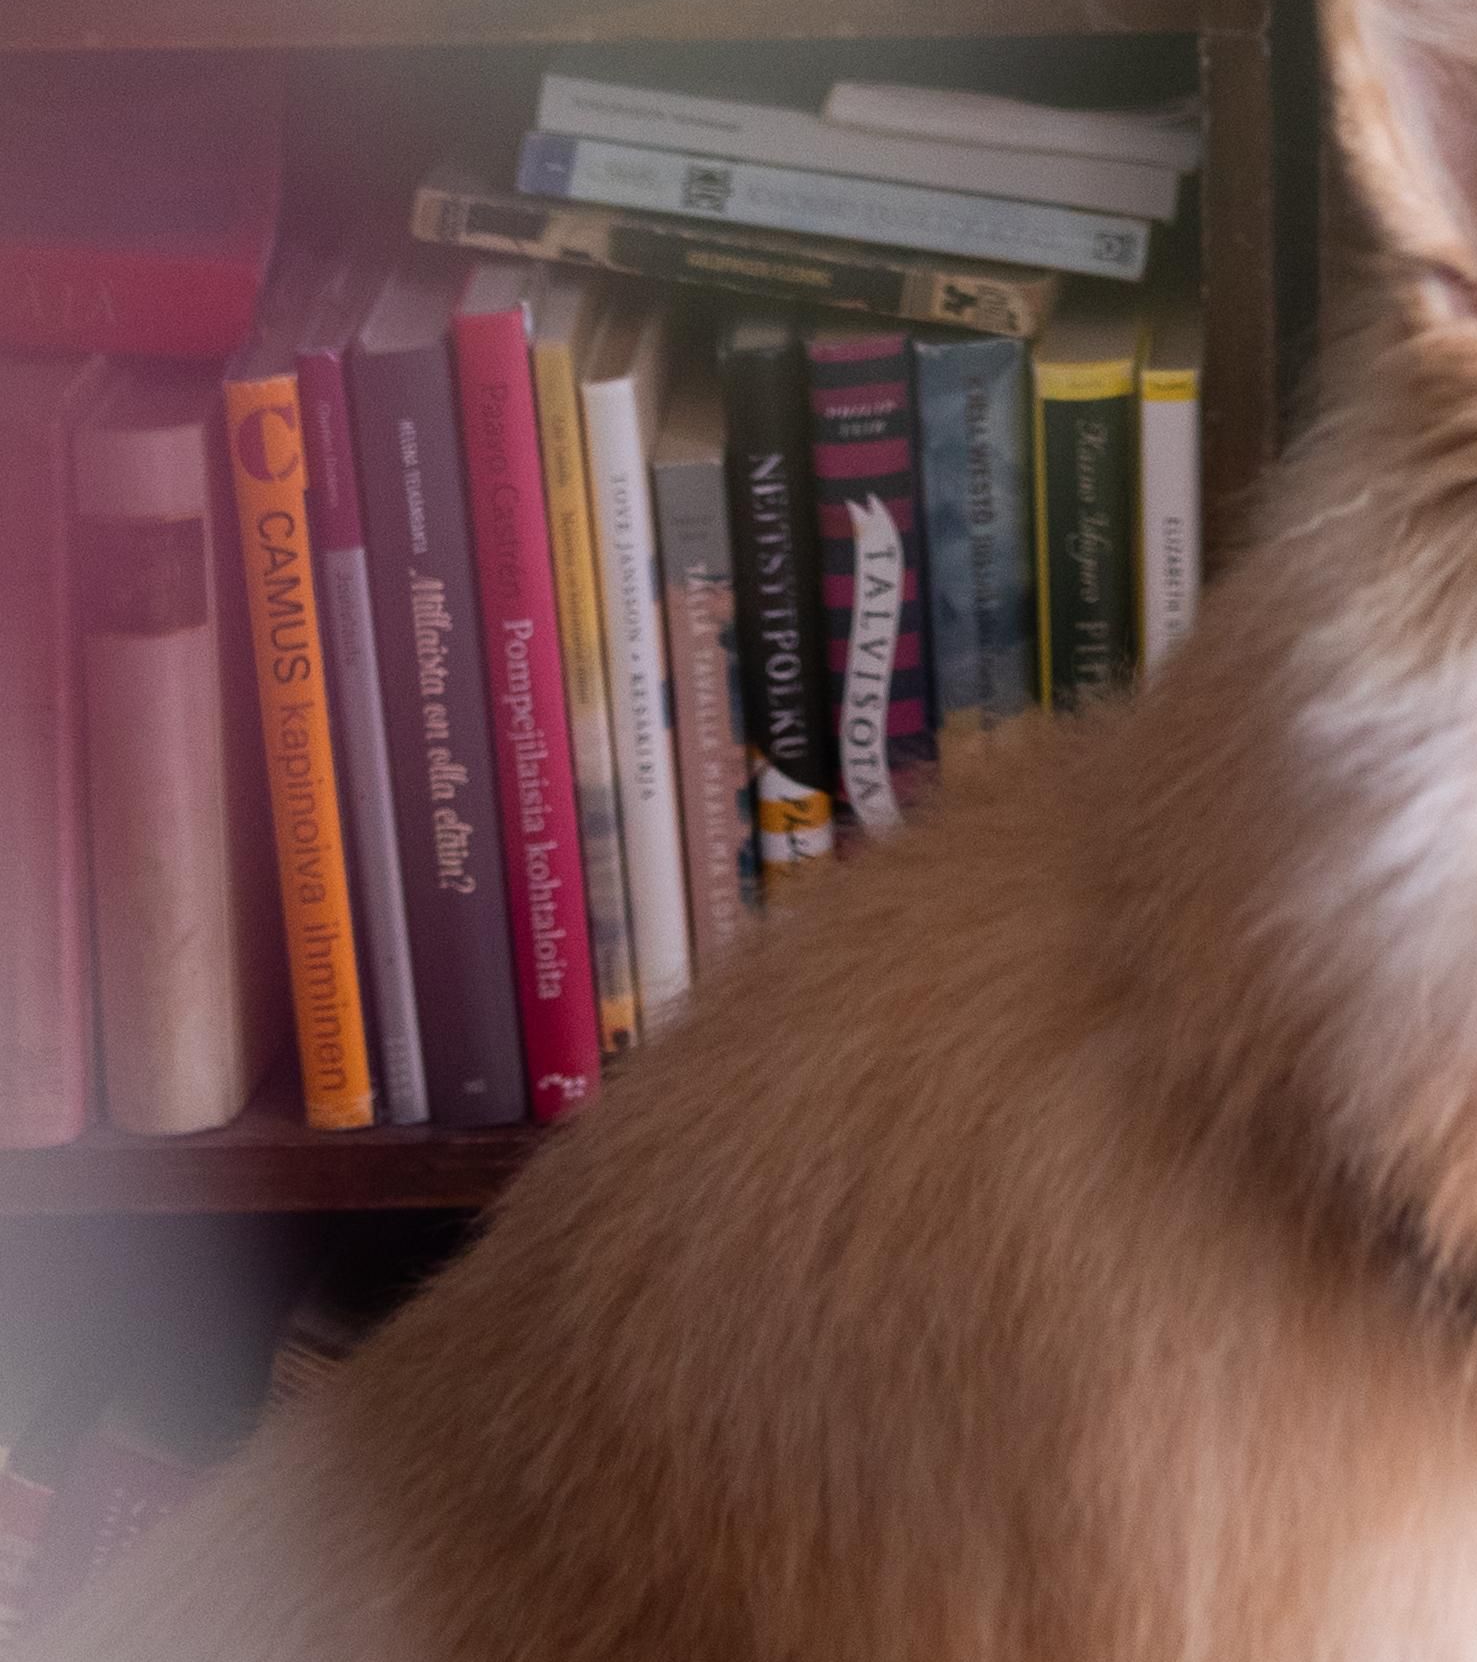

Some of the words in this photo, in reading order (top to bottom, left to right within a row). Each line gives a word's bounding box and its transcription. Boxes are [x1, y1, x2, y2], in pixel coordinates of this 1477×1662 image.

[254, 509, 311, 685] CAMUS
[406, 567, 454, 697] Millaista
[747, 452, 806, 761] NEITSYTPOLKU
[842, 544, 897, 803] TALVISOTA
[272, 701, 326, 906] kapinoiva
[428, 744, 468, 800] olla
[500, 618, 556, 835] Pompejilaisia
[301, 918, 351, 1092] ihminen
[521, 842, 569, 1001] kohtaloita
